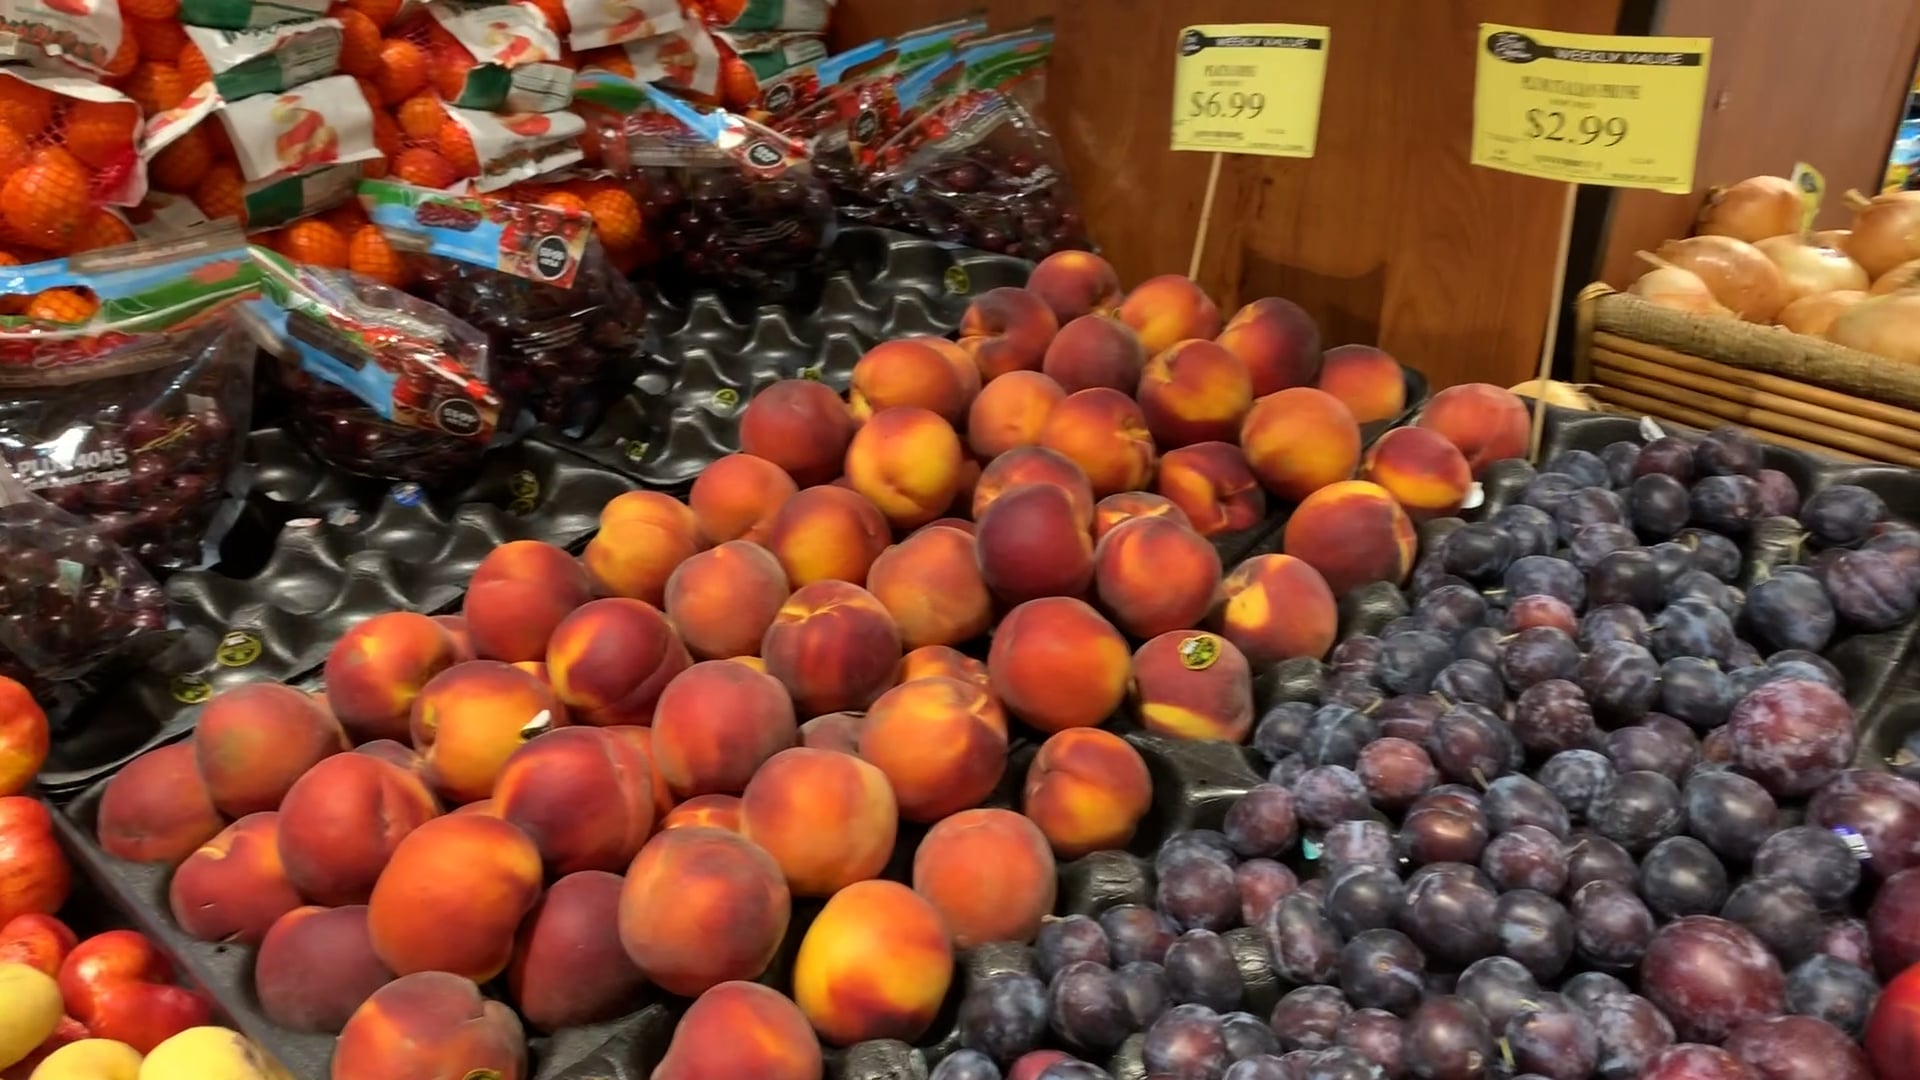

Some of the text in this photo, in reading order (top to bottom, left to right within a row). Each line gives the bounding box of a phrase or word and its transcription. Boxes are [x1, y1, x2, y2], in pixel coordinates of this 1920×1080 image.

[1553, 48, 1683, 65] WEEKLY VALUE
[1190, 91, 1265, 119] $6.99
[1523, 107, 1628, 147] $2.99
[75, 447, 128, 469] 4045
